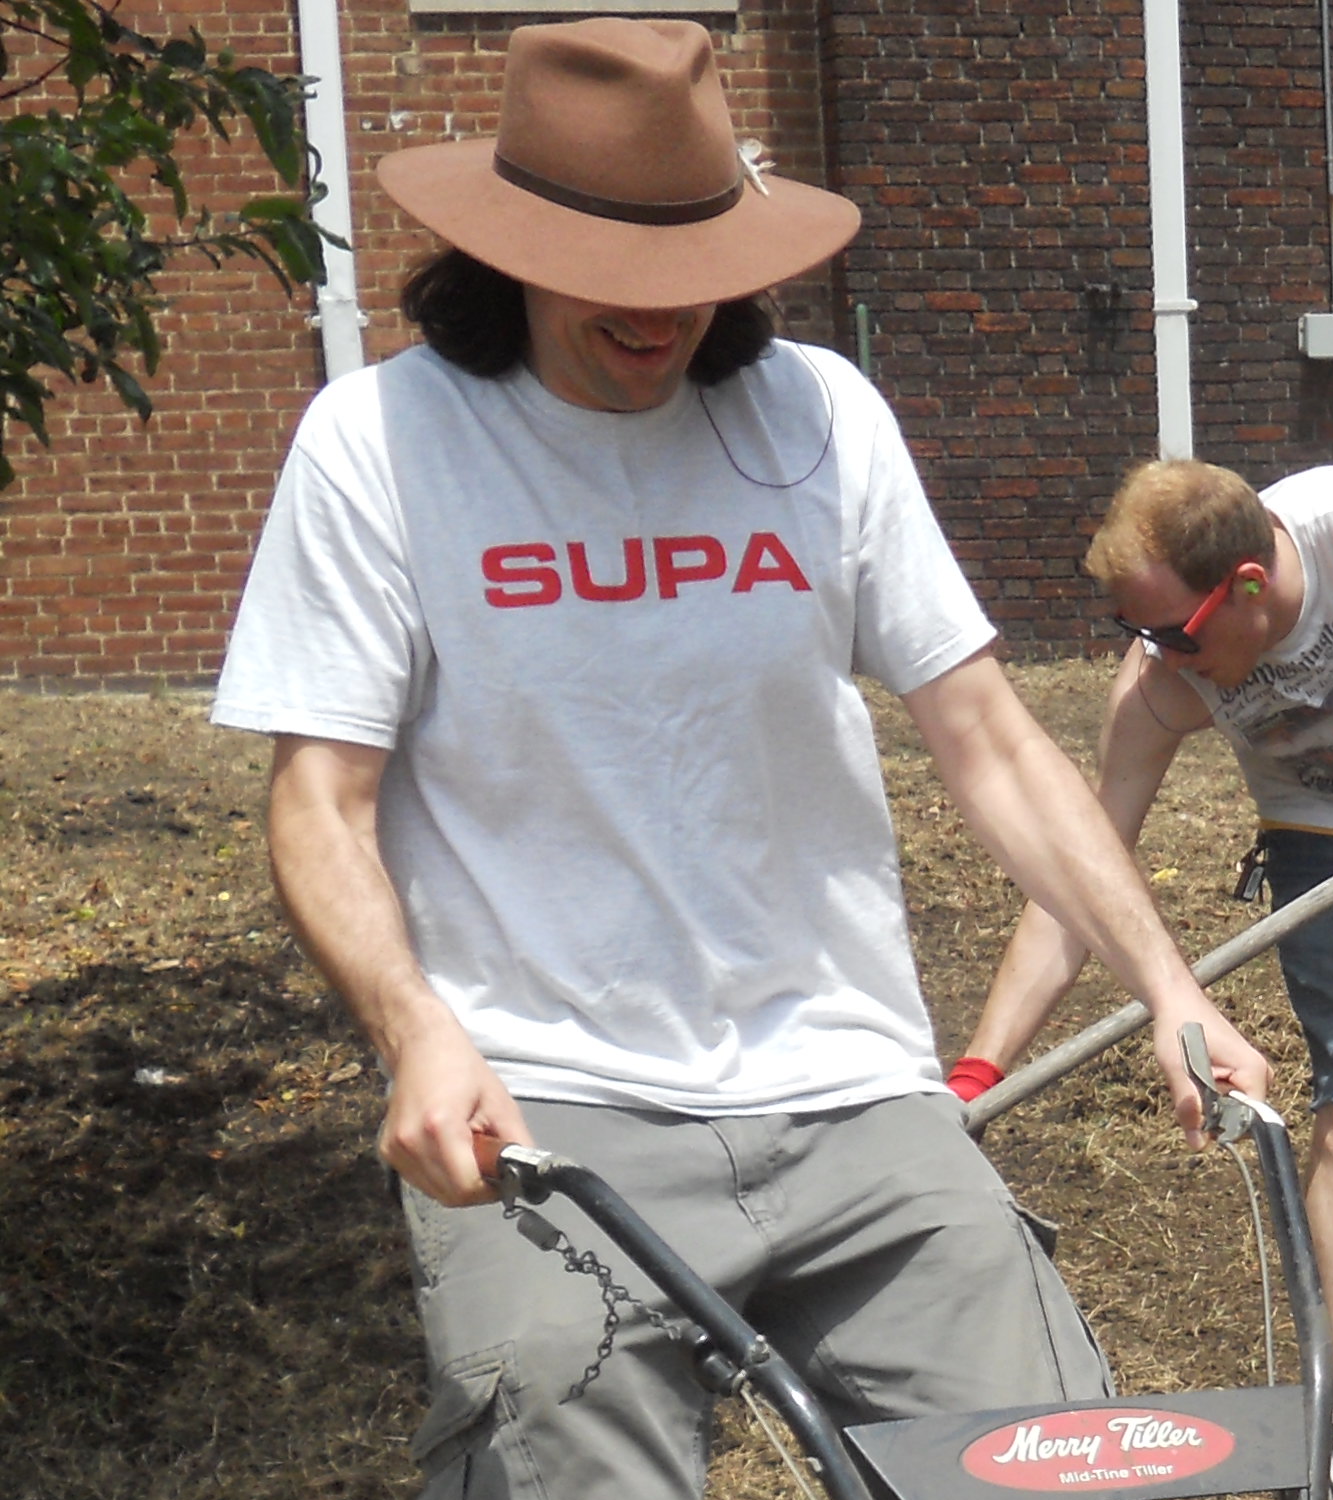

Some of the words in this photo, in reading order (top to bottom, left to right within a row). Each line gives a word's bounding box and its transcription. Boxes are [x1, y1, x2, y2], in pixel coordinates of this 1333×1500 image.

[481, 531, 813, 608] SUPA
[992, 1425, 1101, 1464] Merry
[1108, 1414, 1202, 1452] Tiller
[1059, 1466, 1129, 1485] Mid-Tine
[1132, 1462, 1174, 1479] Tiller
